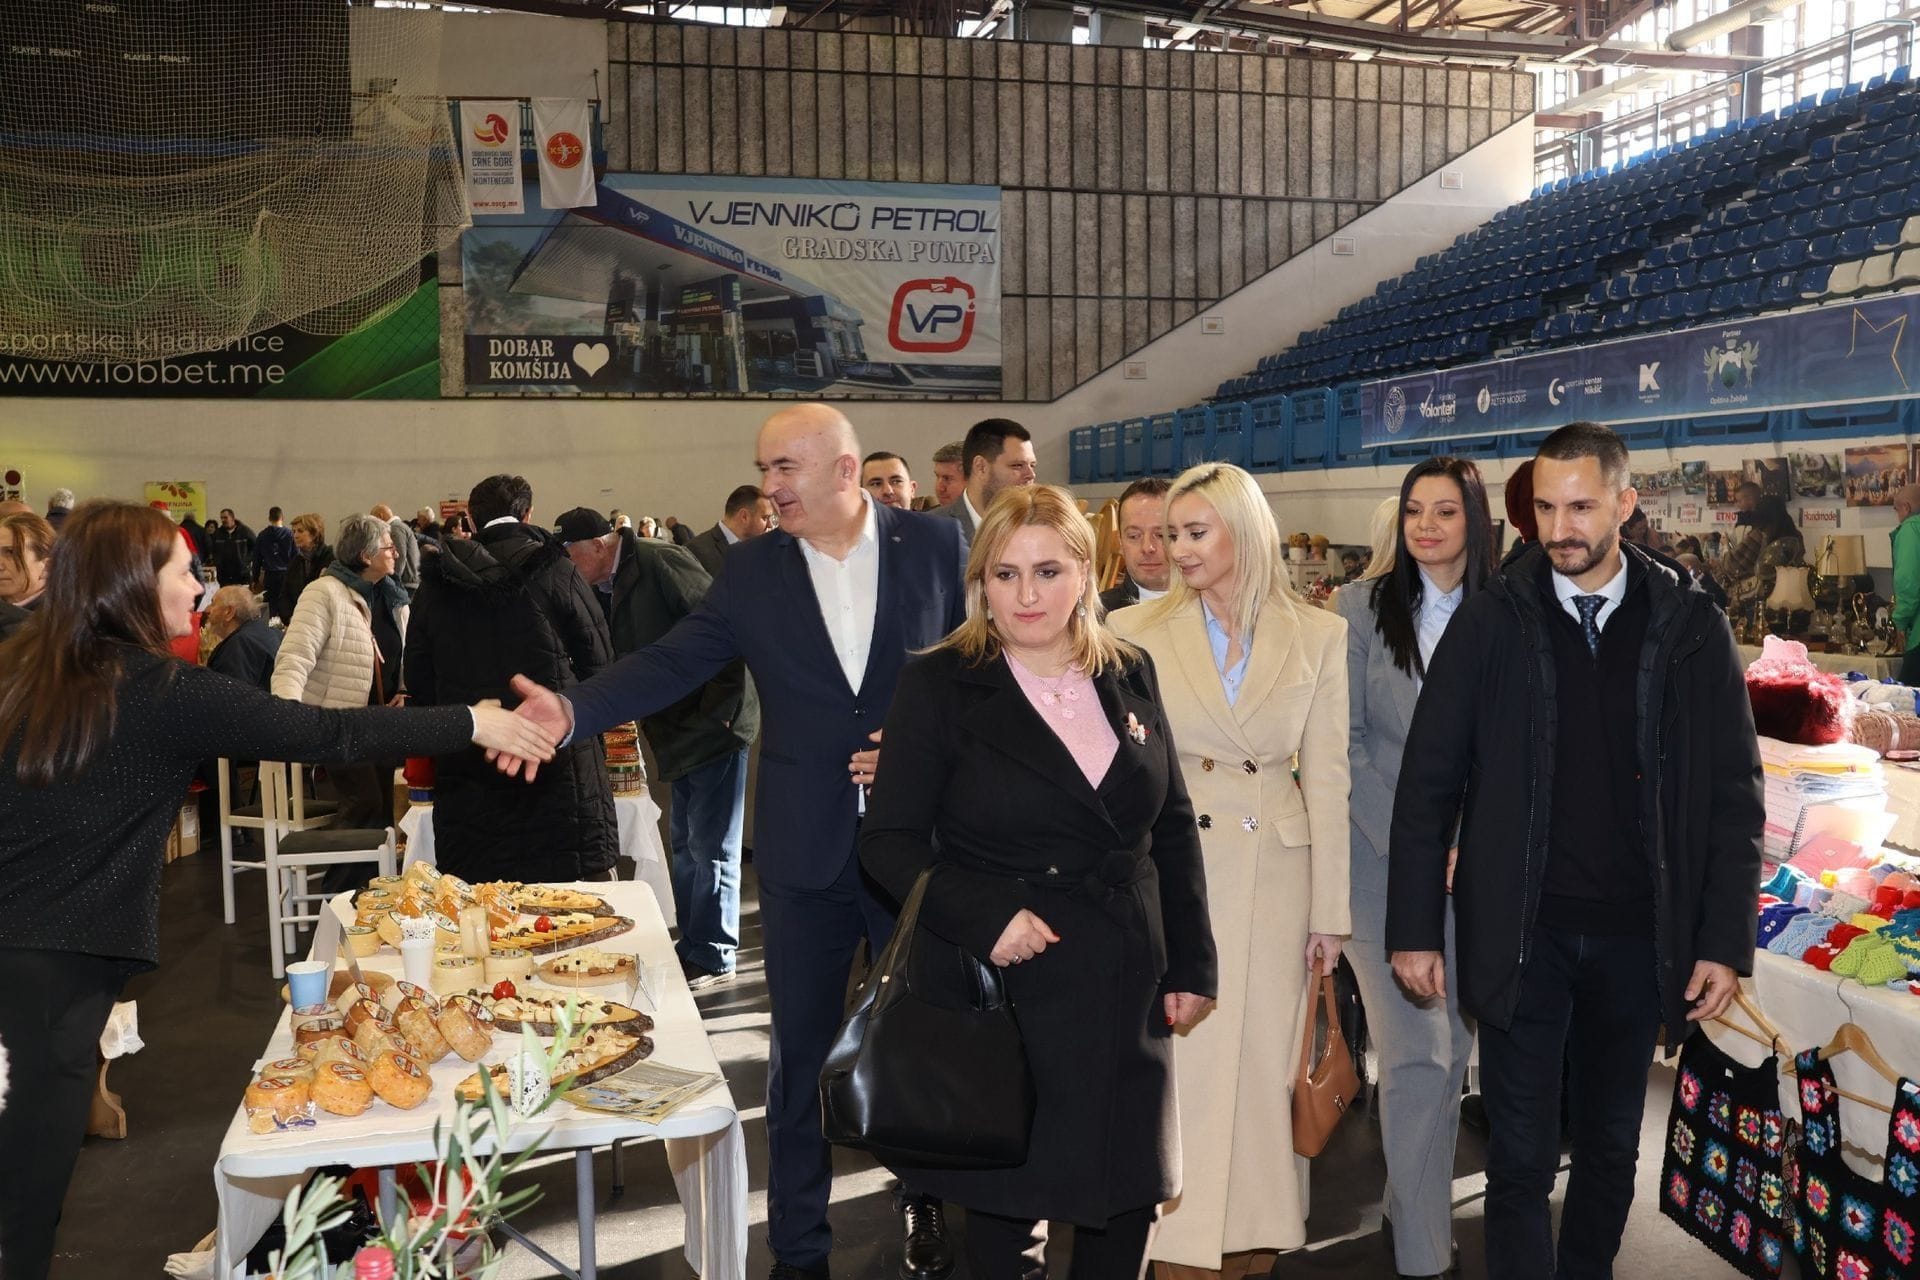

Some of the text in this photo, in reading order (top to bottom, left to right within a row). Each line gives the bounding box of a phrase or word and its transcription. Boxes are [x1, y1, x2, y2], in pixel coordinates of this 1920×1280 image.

[85, 3, 117, 14] PERIOD
[12, 46, 82, 58] PLAYER PENALTY
[123, 53, 192, 64] PLAYER PENALTY
[471, 157, 513, 167] CRNE GORE
[473, 177, 515, 185] MONTENEGRO
[688, 200, 996, 233] VJENNIKO PETROL
[672, 224, 743, 265] VJENNIKO
[782, 235, 995, 265] GRADSKA PUMPA
[906, 303, 963, 333] VP
[0, 329, 285, 355] sportske kladionice
[488, 339, 555, 357] DOBAR
[0, 357, 286, 384] www.lobbet.me
[489, 357, 572, 380] KOMŠIJA
[1639, 361, 1661, 392] K
[1507, 395, 1527, 405] MODUS
[1803, 510, 1837, 522] Handmade
